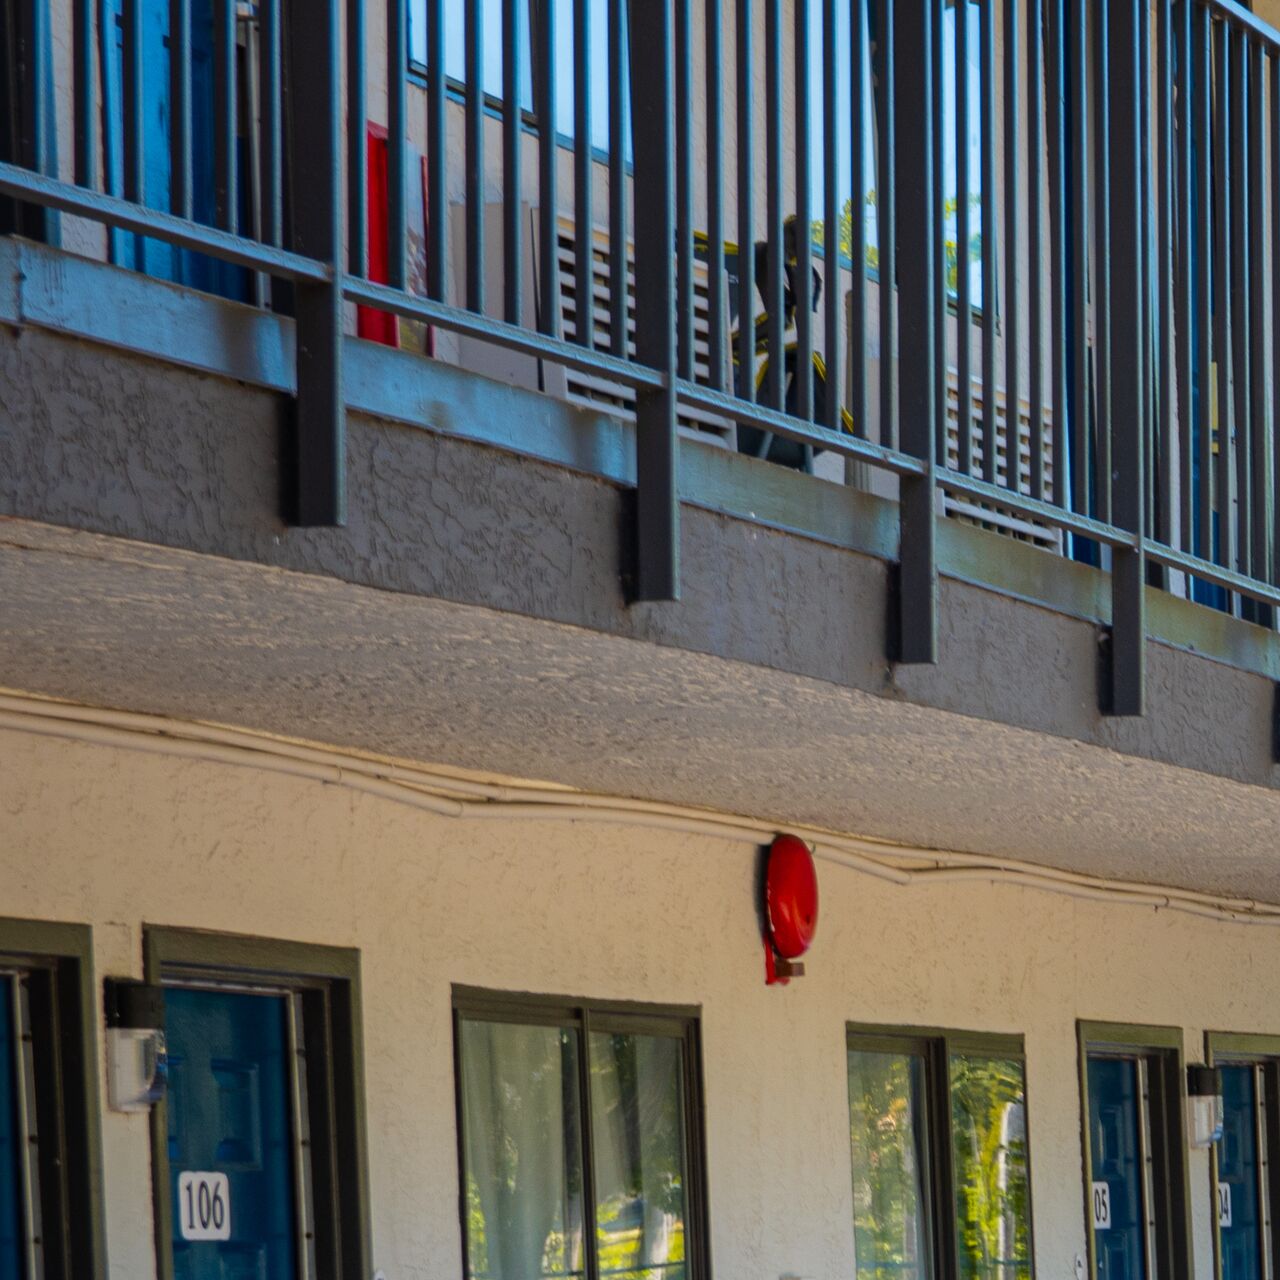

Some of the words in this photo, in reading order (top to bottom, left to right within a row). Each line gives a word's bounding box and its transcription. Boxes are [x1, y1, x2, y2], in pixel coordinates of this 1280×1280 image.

[185, 1180, 225, 1230] 106
[1094, 1188, 1108, 1223] 05
[1218, 1187, 1229, 1220] 04
